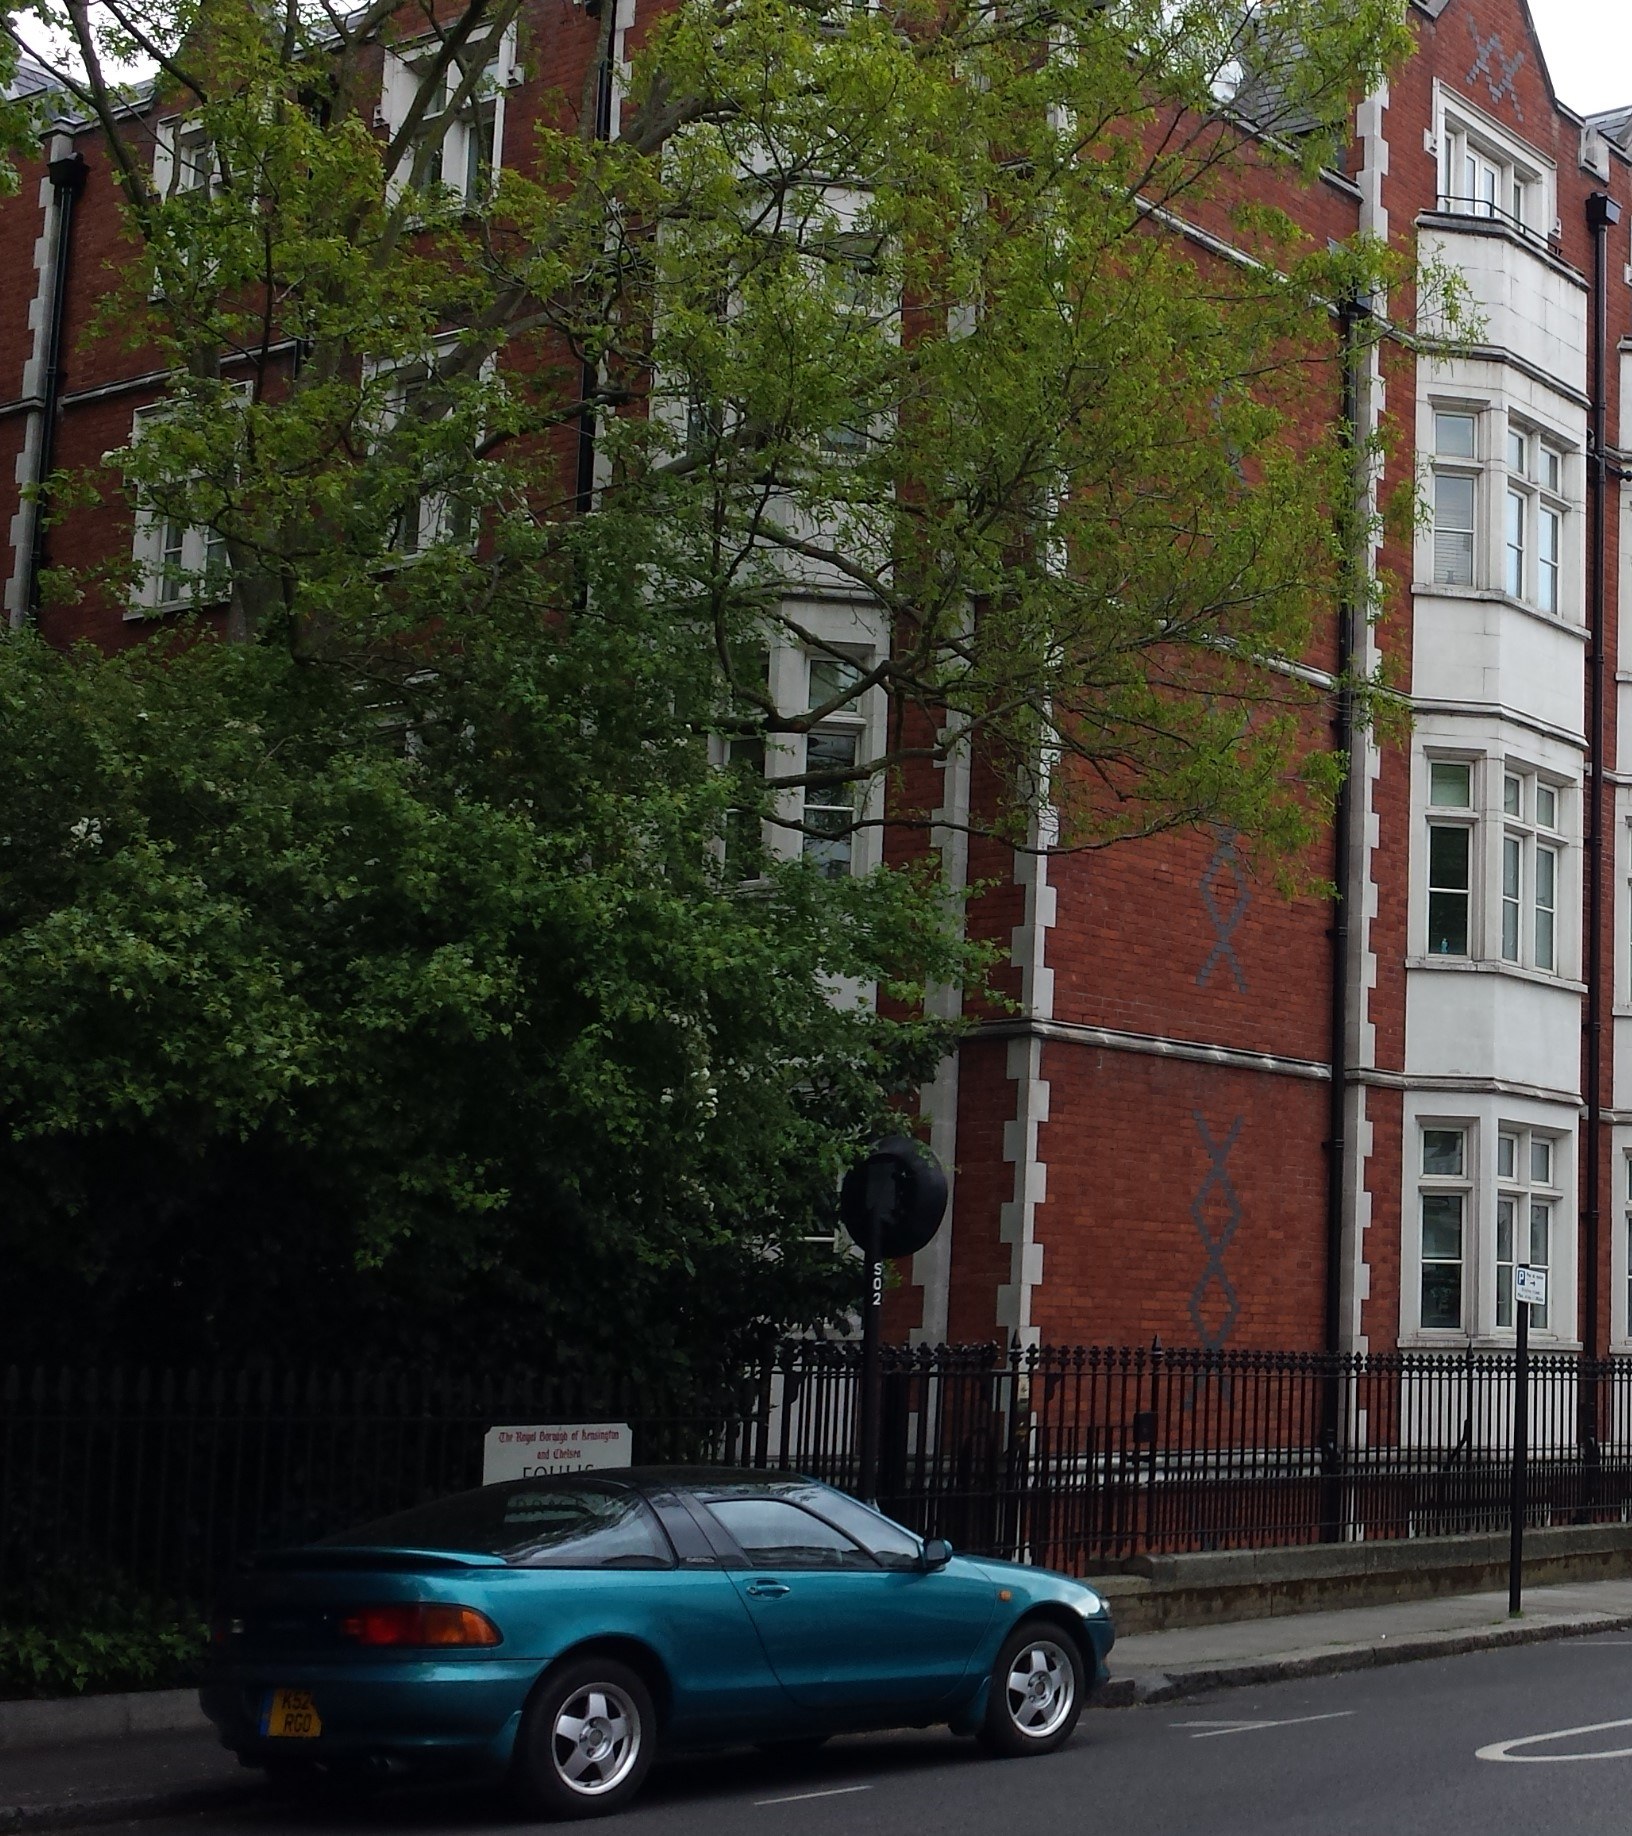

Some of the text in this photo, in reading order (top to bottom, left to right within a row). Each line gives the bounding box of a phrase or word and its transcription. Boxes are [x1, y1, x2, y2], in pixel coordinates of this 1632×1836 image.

[499, 1429, 619, 1445] The Royal Borough of Kensington
[537, 1448, 581, 1459] and Chelsea
